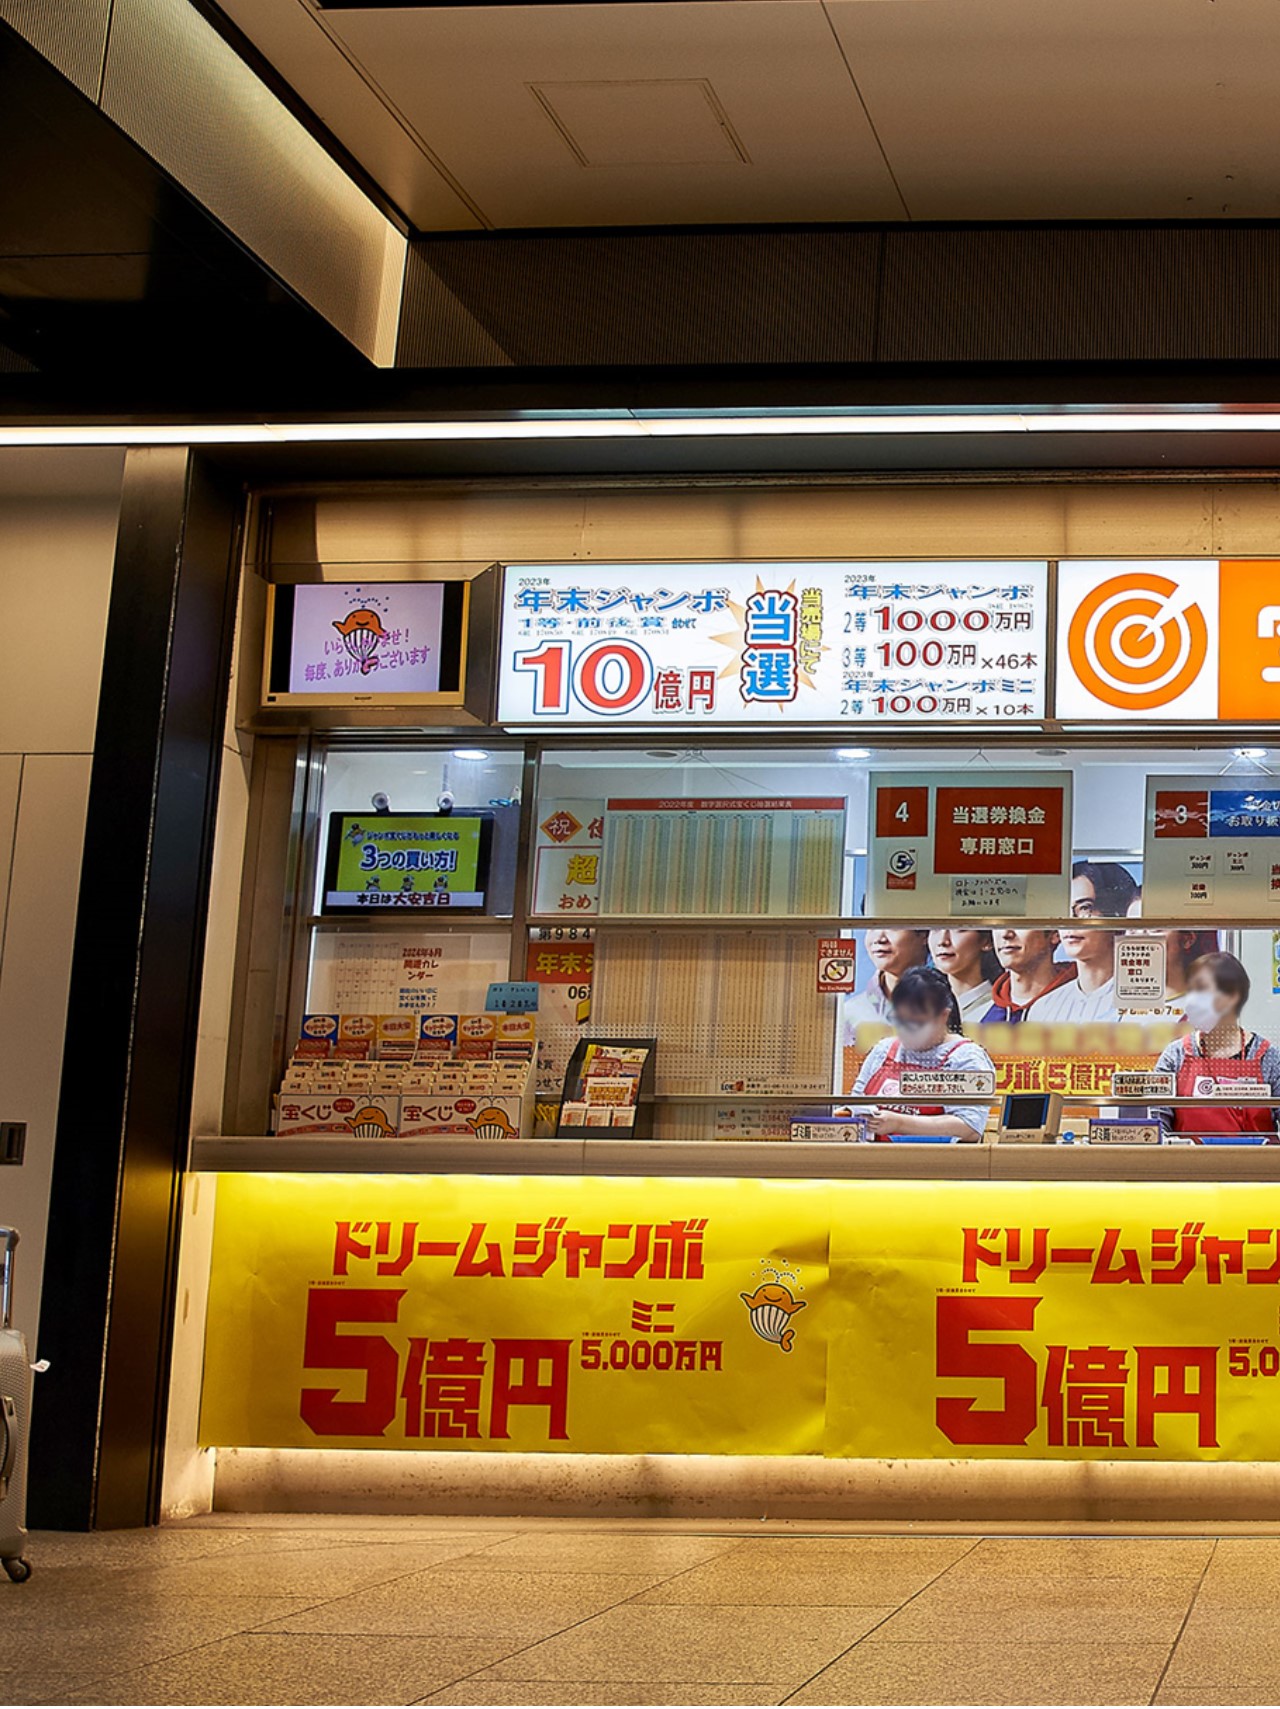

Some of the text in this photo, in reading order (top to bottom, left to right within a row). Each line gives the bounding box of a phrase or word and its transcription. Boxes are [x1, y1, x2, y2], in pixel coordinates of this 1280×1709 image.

[518, 577, 550, 586] 2023年
[844, 575, 876, 583] 2023年
[516, 588, 730, 613] 年末ジャンボ
[845, 584, 1034, 601] 年末ジャンボ
[843, 605, 1032, 633] 2等 1000万円
[800, 588, 823, 674] 当売場にて
[742, 590, 798, 702] 当選
[842, 647, 867, 668] 3等
[875, 640, 978, 668] 100万円
[513, 637, 718, 716] 10億円
[843, 679, 1035, 693] 年末ジャンボミニ
[841, 698, 865, 714] 2等
[871, 696, 972, 714] 100万円
[895, 801, 909, 823] 4
[952, 806, 1046, 825] 当選券換金
[1174, 803, 1188, 825] 3
[549, 819, 571, 836] 祝
[960, 837, 1034, 855] 専用窓口
[360, 843, 457, 872] 3つの買い方!
[566, 854, 599, 886] 超
[357, 892, 450, 905] 本日は大安吉日
[558, 894, 599, 910] おめ
[820, 948, 854, 957] できません
[282, 1104, 332, 1121] 宝くじ
[403, 1105, 453, 1121] 宝くじ
[332, 1216, 709, 1279] ドリームジャンボ
[631, 1300, 675, 1333] ミニ
[300, 1288, 575, 1440] 5億円
[935, 1296, 1221, 1449] 5億円
